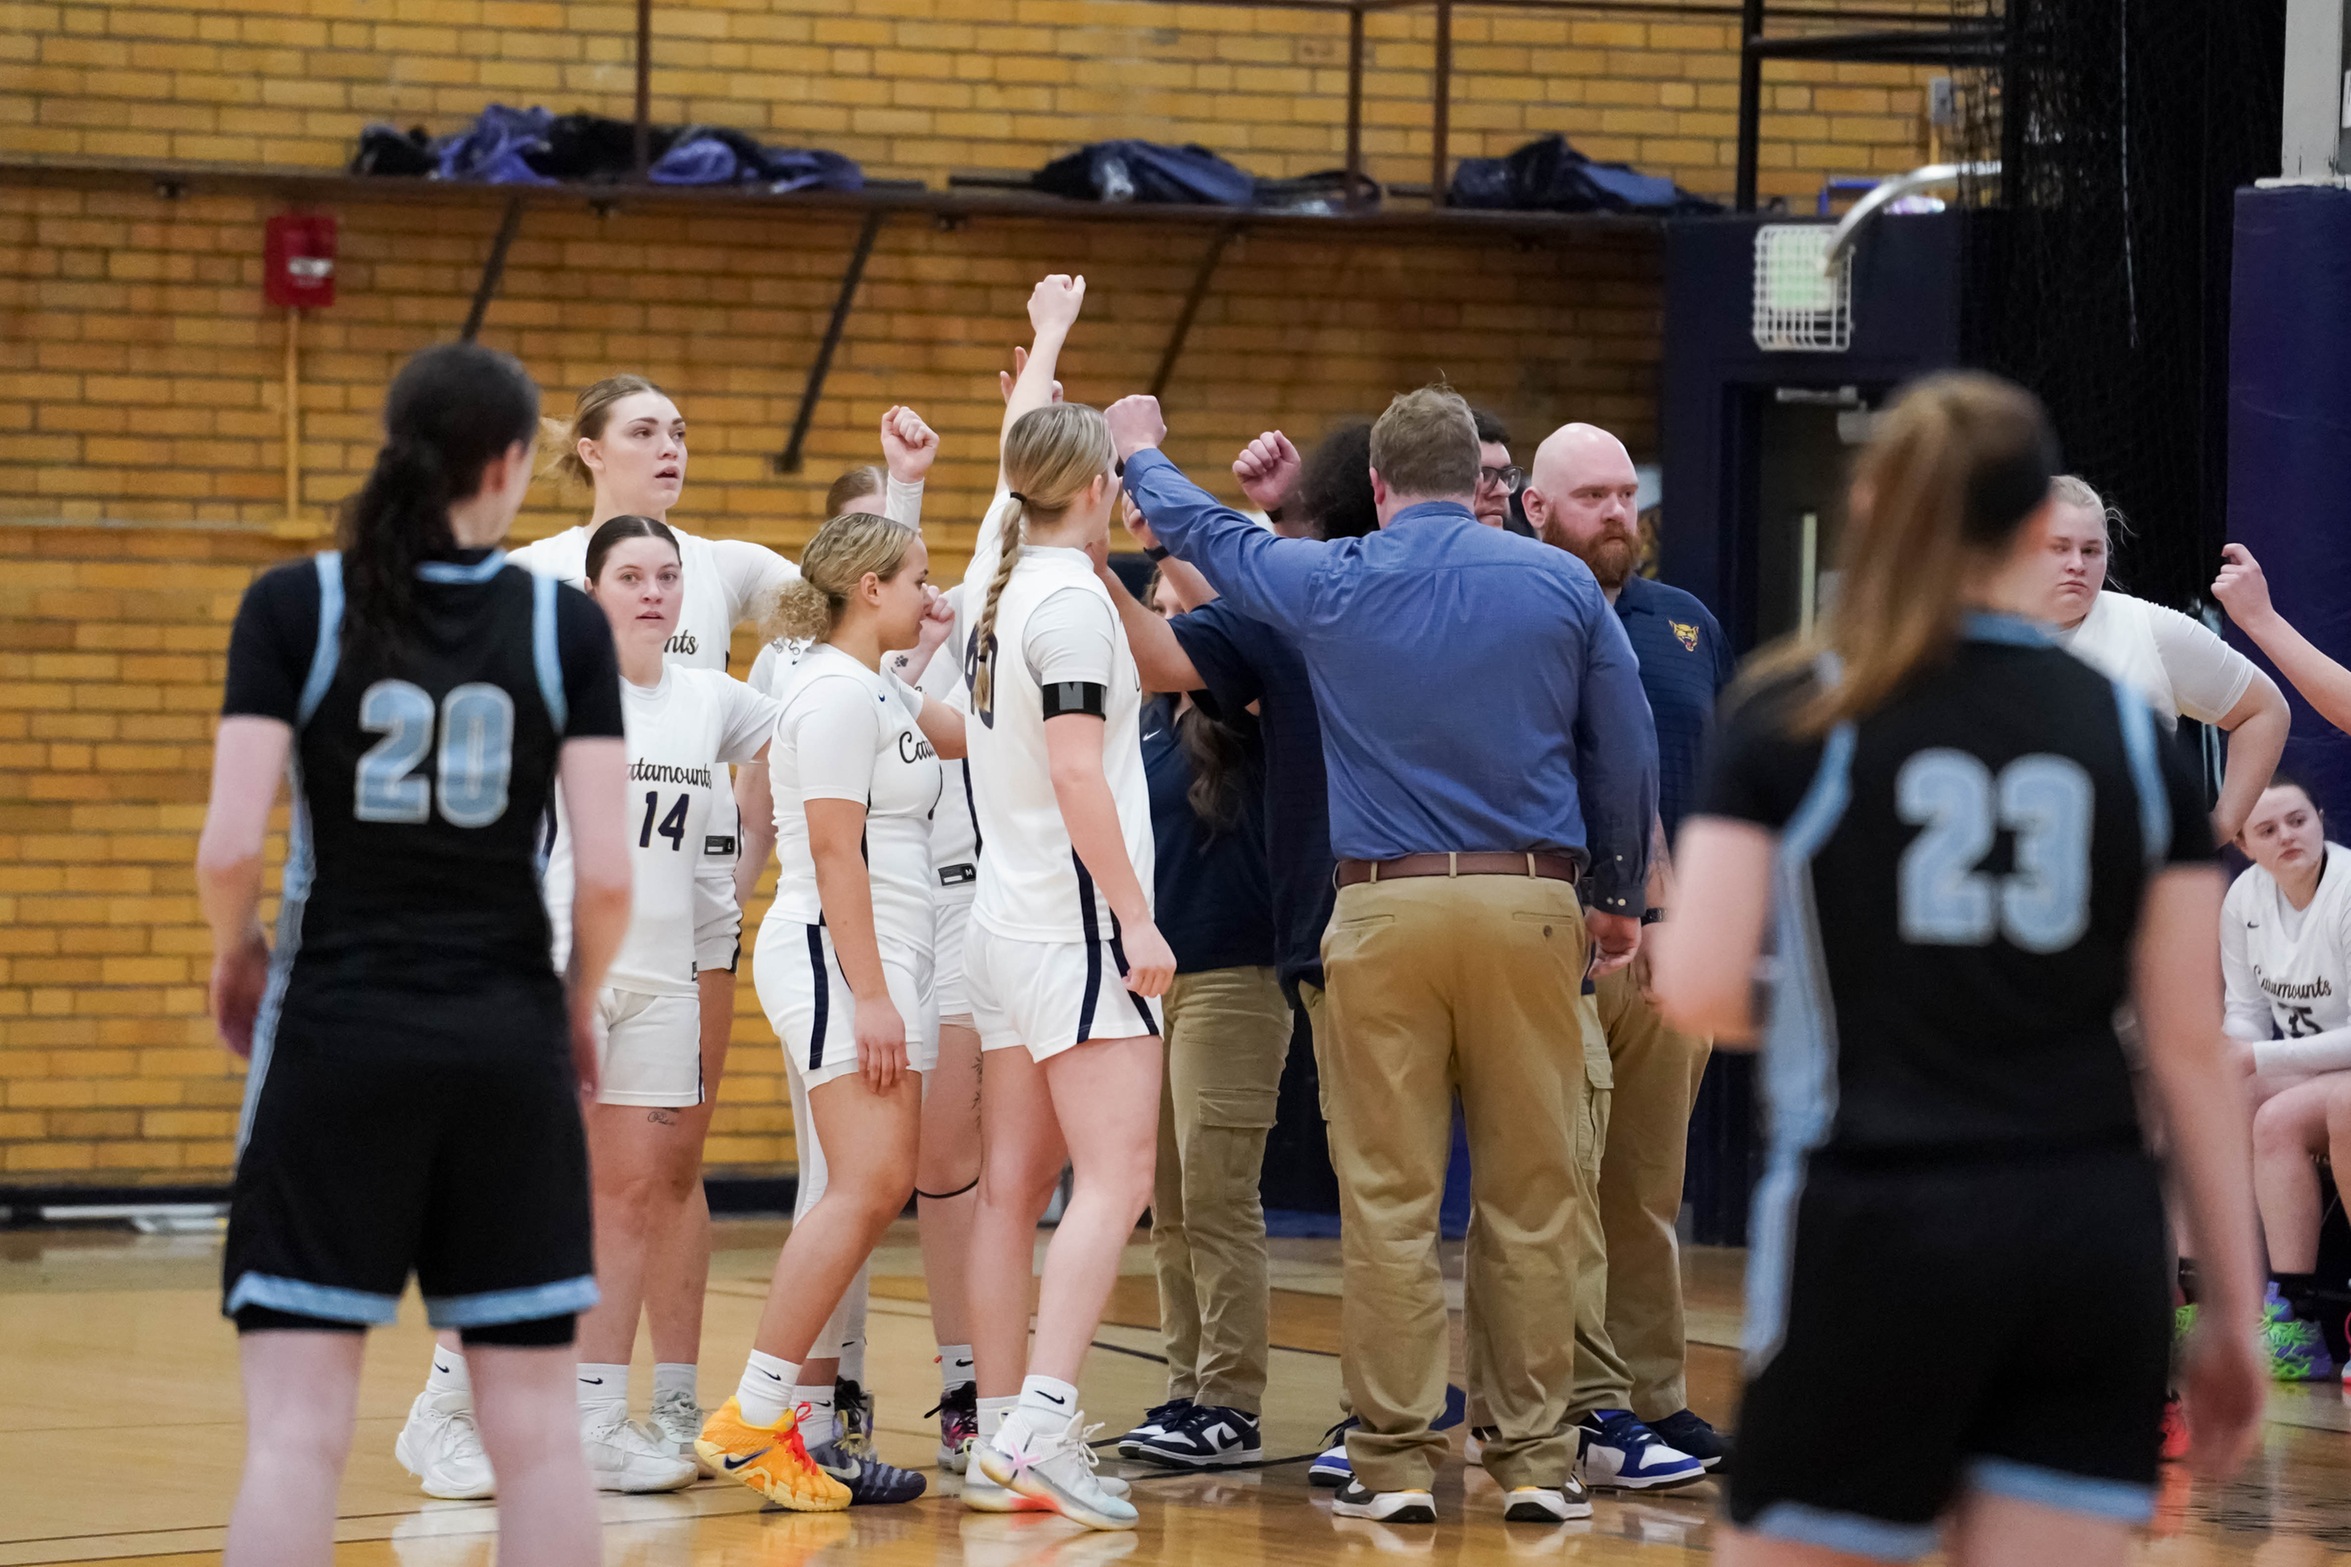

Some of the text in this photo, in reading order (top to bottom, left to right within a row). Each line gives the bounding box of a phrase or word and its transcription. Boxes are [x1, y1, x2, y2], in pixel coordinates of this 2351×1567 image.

[353, 678, 516, 829] 20
[626, 757, 712, 790] atamounts
[639, 790, 690, 852] 14
[1894, 746, 2096, 955] 23
[965, 868, 973, 877] M
